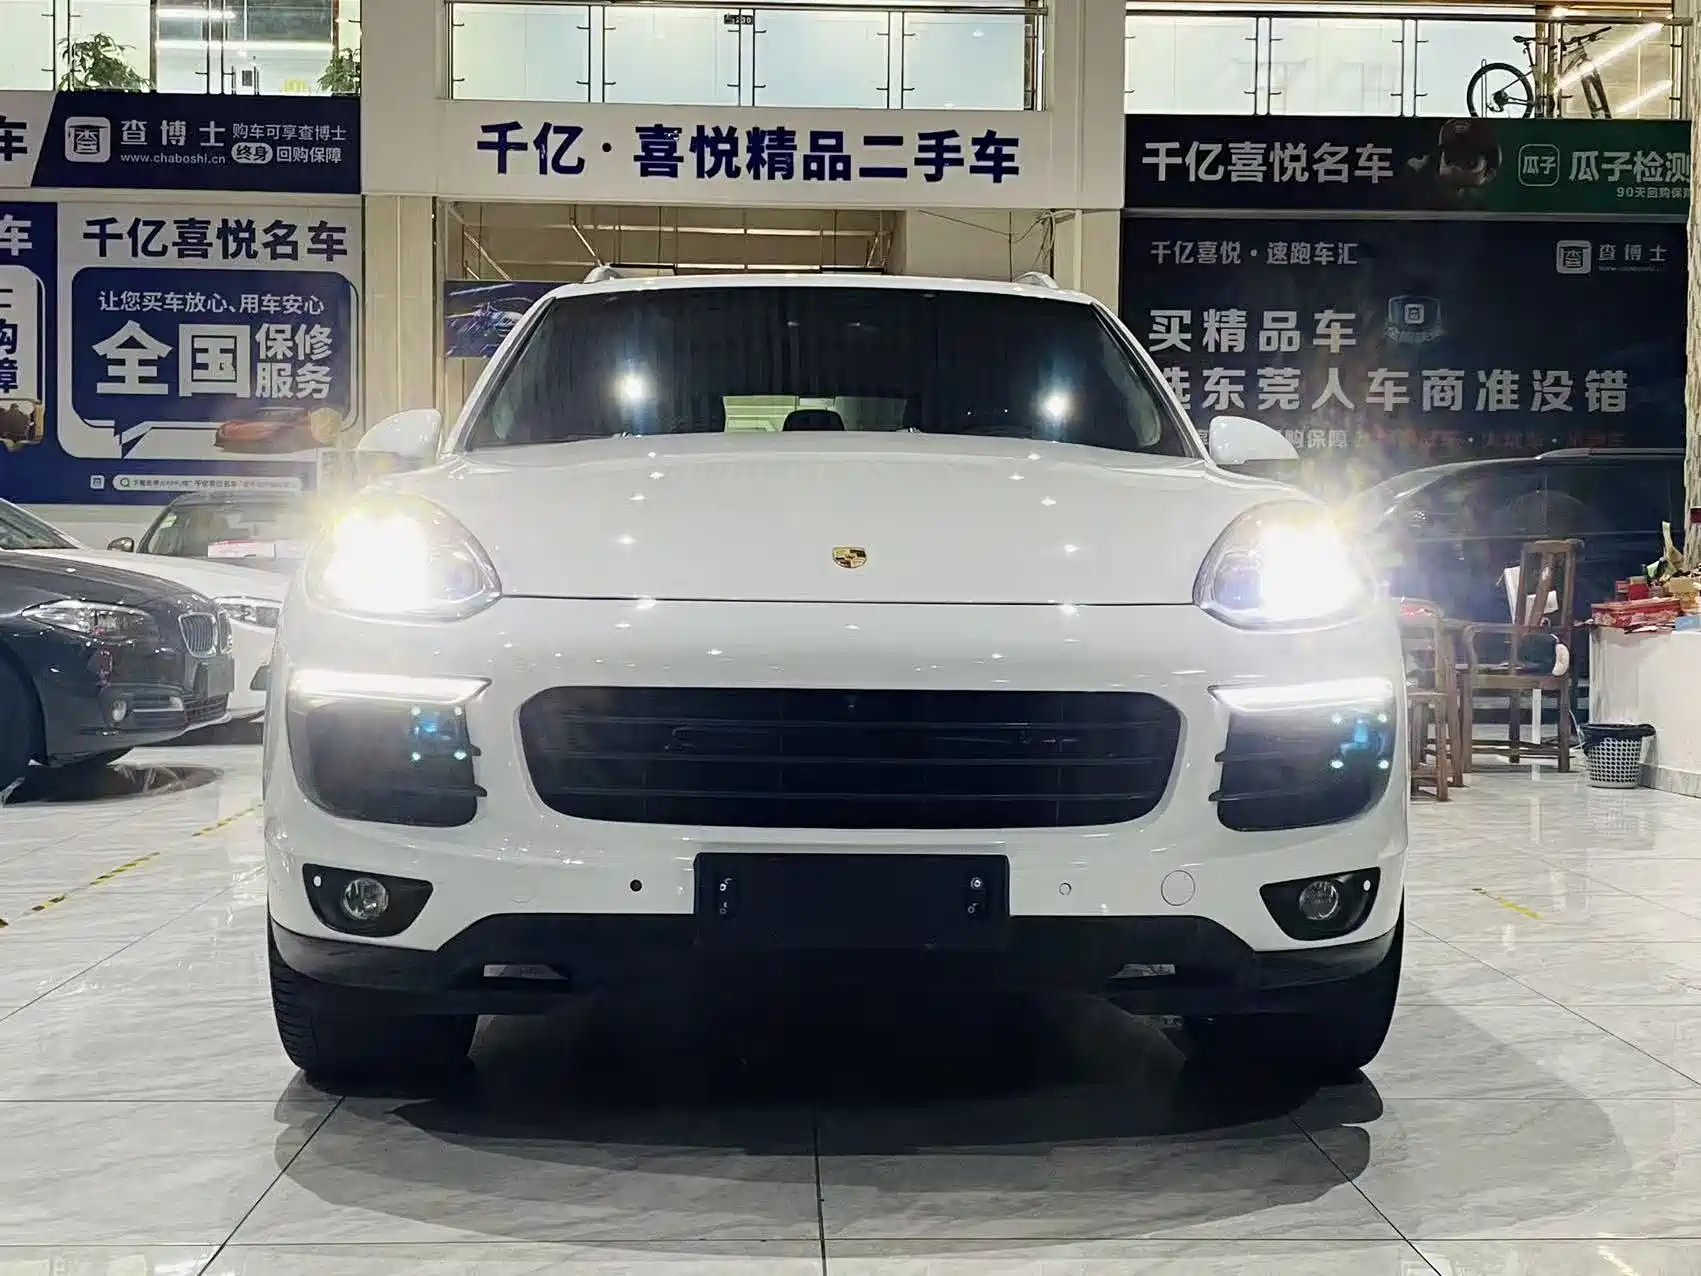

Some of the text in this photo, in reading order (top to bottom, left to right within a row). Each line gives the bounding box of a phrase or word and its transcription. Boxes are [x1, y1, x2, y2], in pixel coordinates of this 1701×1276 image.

[120, 119, 226, 147] 查博士
[232, 123, 347, 142] 购车可享查博士
[120, 152, 226, 164] www.chaboshi.cn
[236, 145, 342, 163] 终身 回购保障
[1142, 140, 1394, 184] 千亿喜悦名车
[1522, 156, 1557, 175] 瓜子
[82, 216, 348, 262] 千亿喜悦名车
[1597, 243, 1668, 262] 查博士
[255, 322, 333, 361] 保修
[1149, 309, 1357, 354] 买精品车
[92, 320, 251, 398] 全国
[255, 362, 333, 399] 服务
